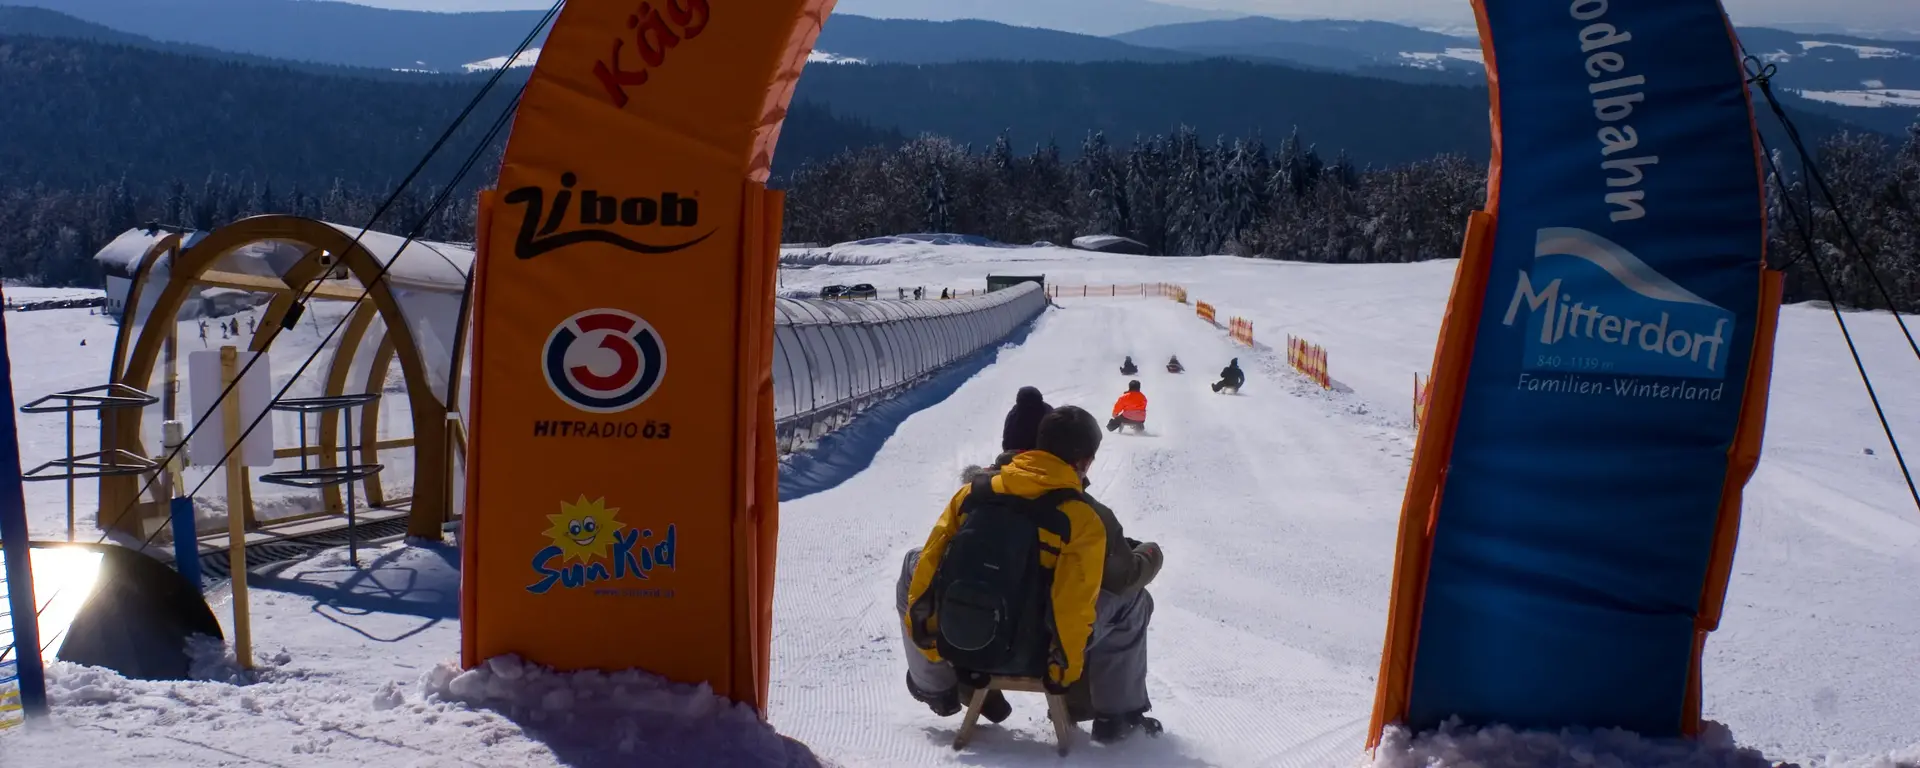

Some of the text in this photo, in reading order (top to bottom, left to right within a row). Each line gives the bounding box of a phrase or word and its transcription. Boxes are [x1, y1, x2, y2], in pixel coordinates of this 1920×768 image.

[1569, 0, 1659, 223] odelbahn
[1502, 269, 1729, 372] Mitterdorf
[1517, 373, 1724, 401] Familien-Winterland
[534, 419, 672, 439] HITRADIO Ö3
